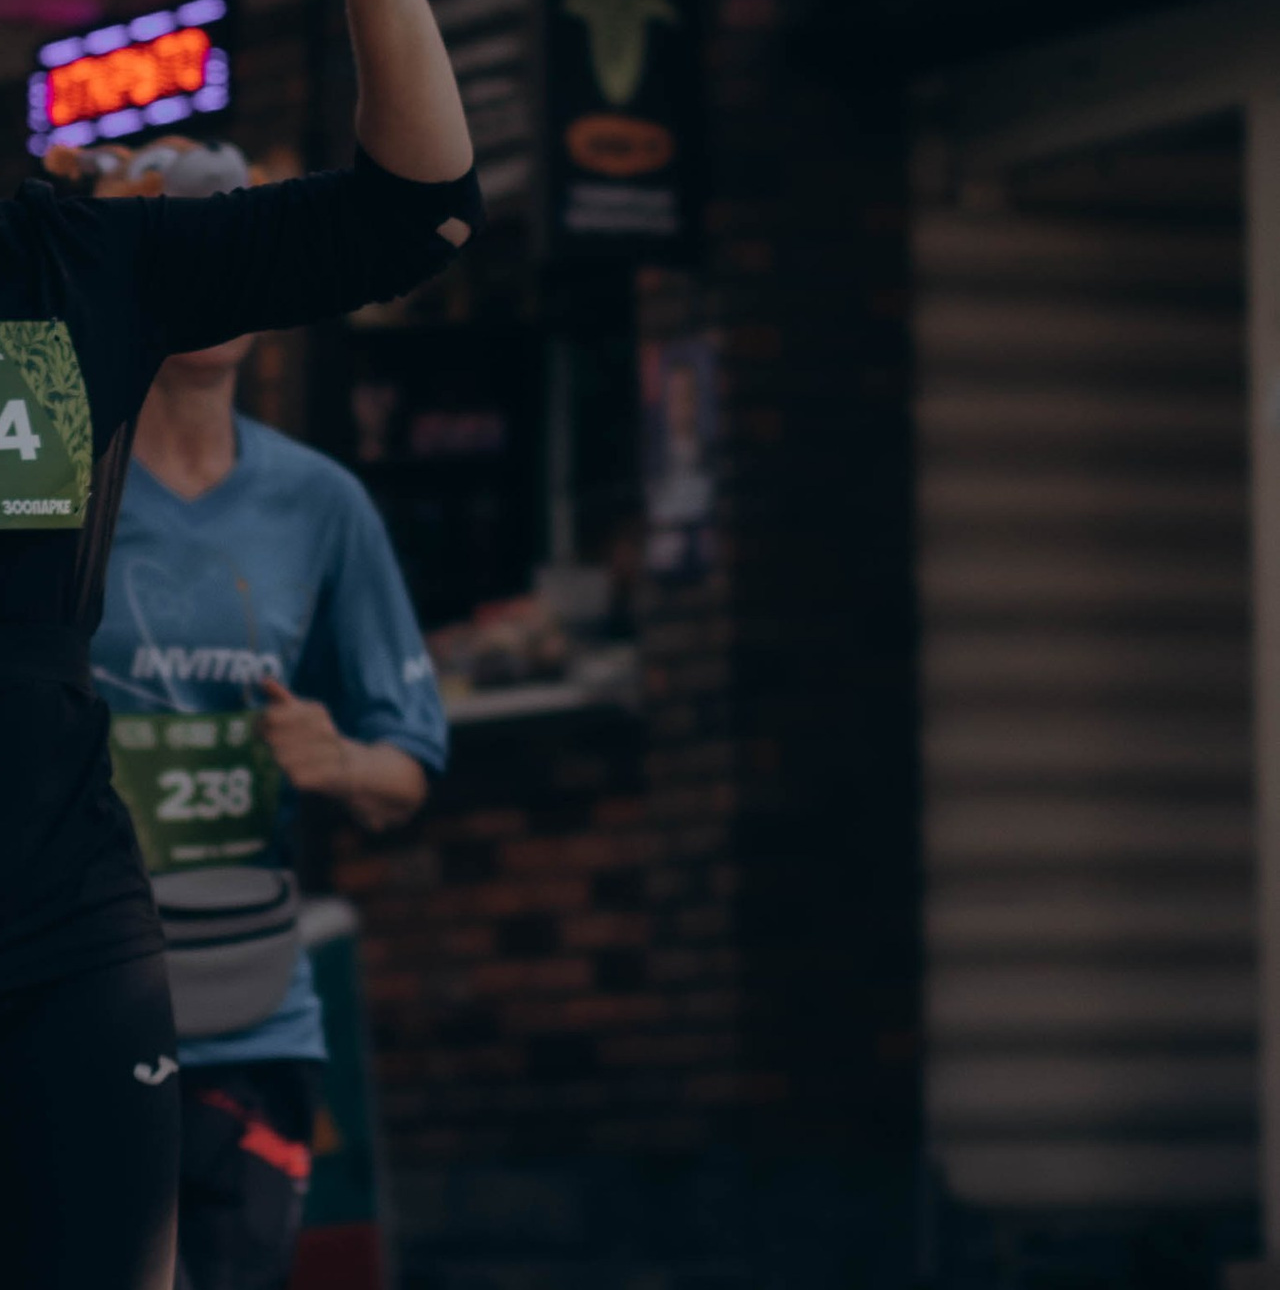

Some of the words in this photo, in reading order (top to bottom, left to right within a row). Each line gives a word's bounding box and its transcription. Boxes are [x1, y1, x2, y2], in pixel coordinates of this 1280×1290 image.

[1, 499, 72, 516] ЗООПАРКЕ
[130, 647, 282, 685] INVITRO
[156, 766, 254, 821] 238
